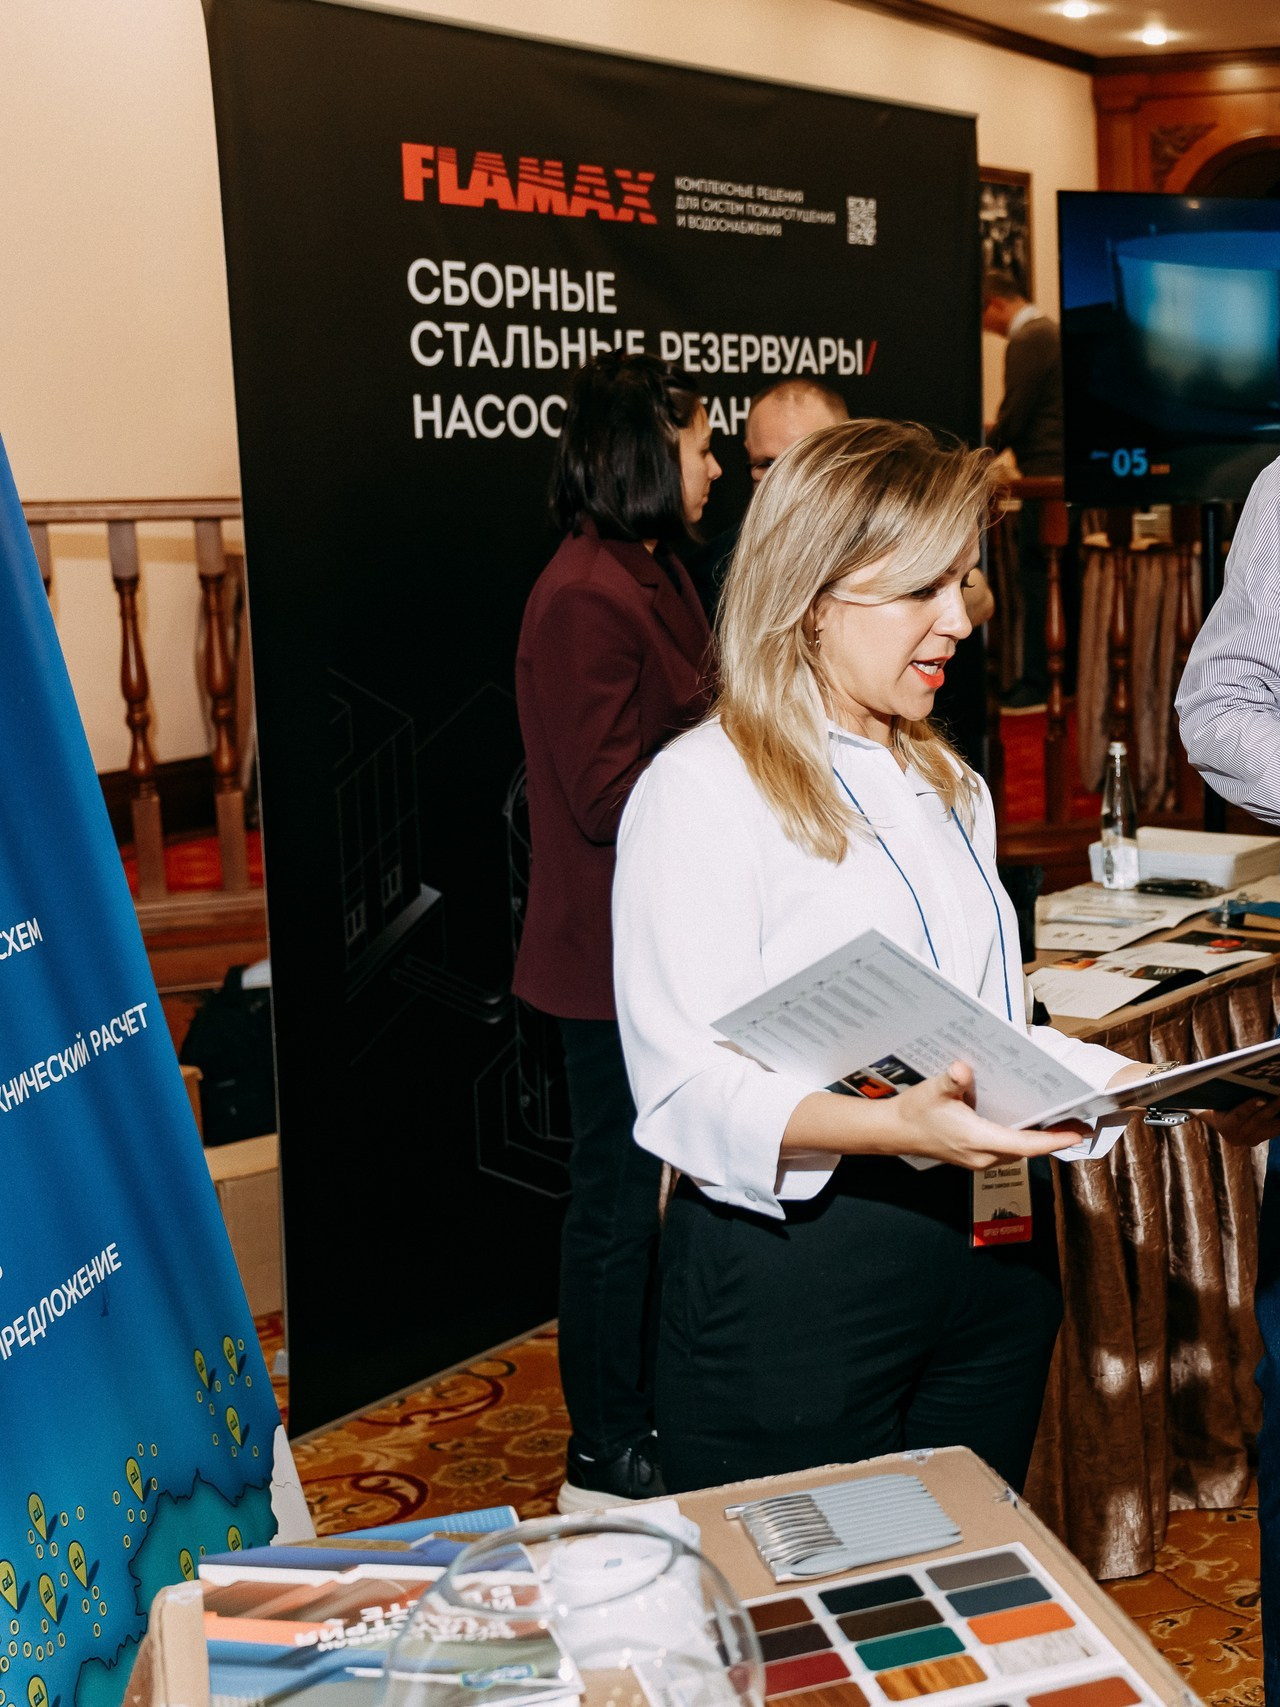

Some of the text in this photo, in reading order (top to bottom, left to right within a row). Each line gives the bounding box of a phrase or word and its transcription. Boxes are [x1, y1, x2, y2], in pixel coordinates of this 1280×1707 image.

[401, 142, 658, 225] FLAMAX
[675, 194, 700, 210] ДЛЯ
[701, 197, 745, 215] СИСТЕМ
[756, 185, 804, 204] РЕШЕНИЯ
[676, 214, 686, 228] И
[406, 257, 618, 314] СБОРНЫЕ
[409, 320, 646, 370] СТАЛЬНЫЕ
[412, 393, 568, 440] НАСОС
[1112, 447, 1148, 477] 05
[89, 1002, 148, 1057] РАСЧЕТ
